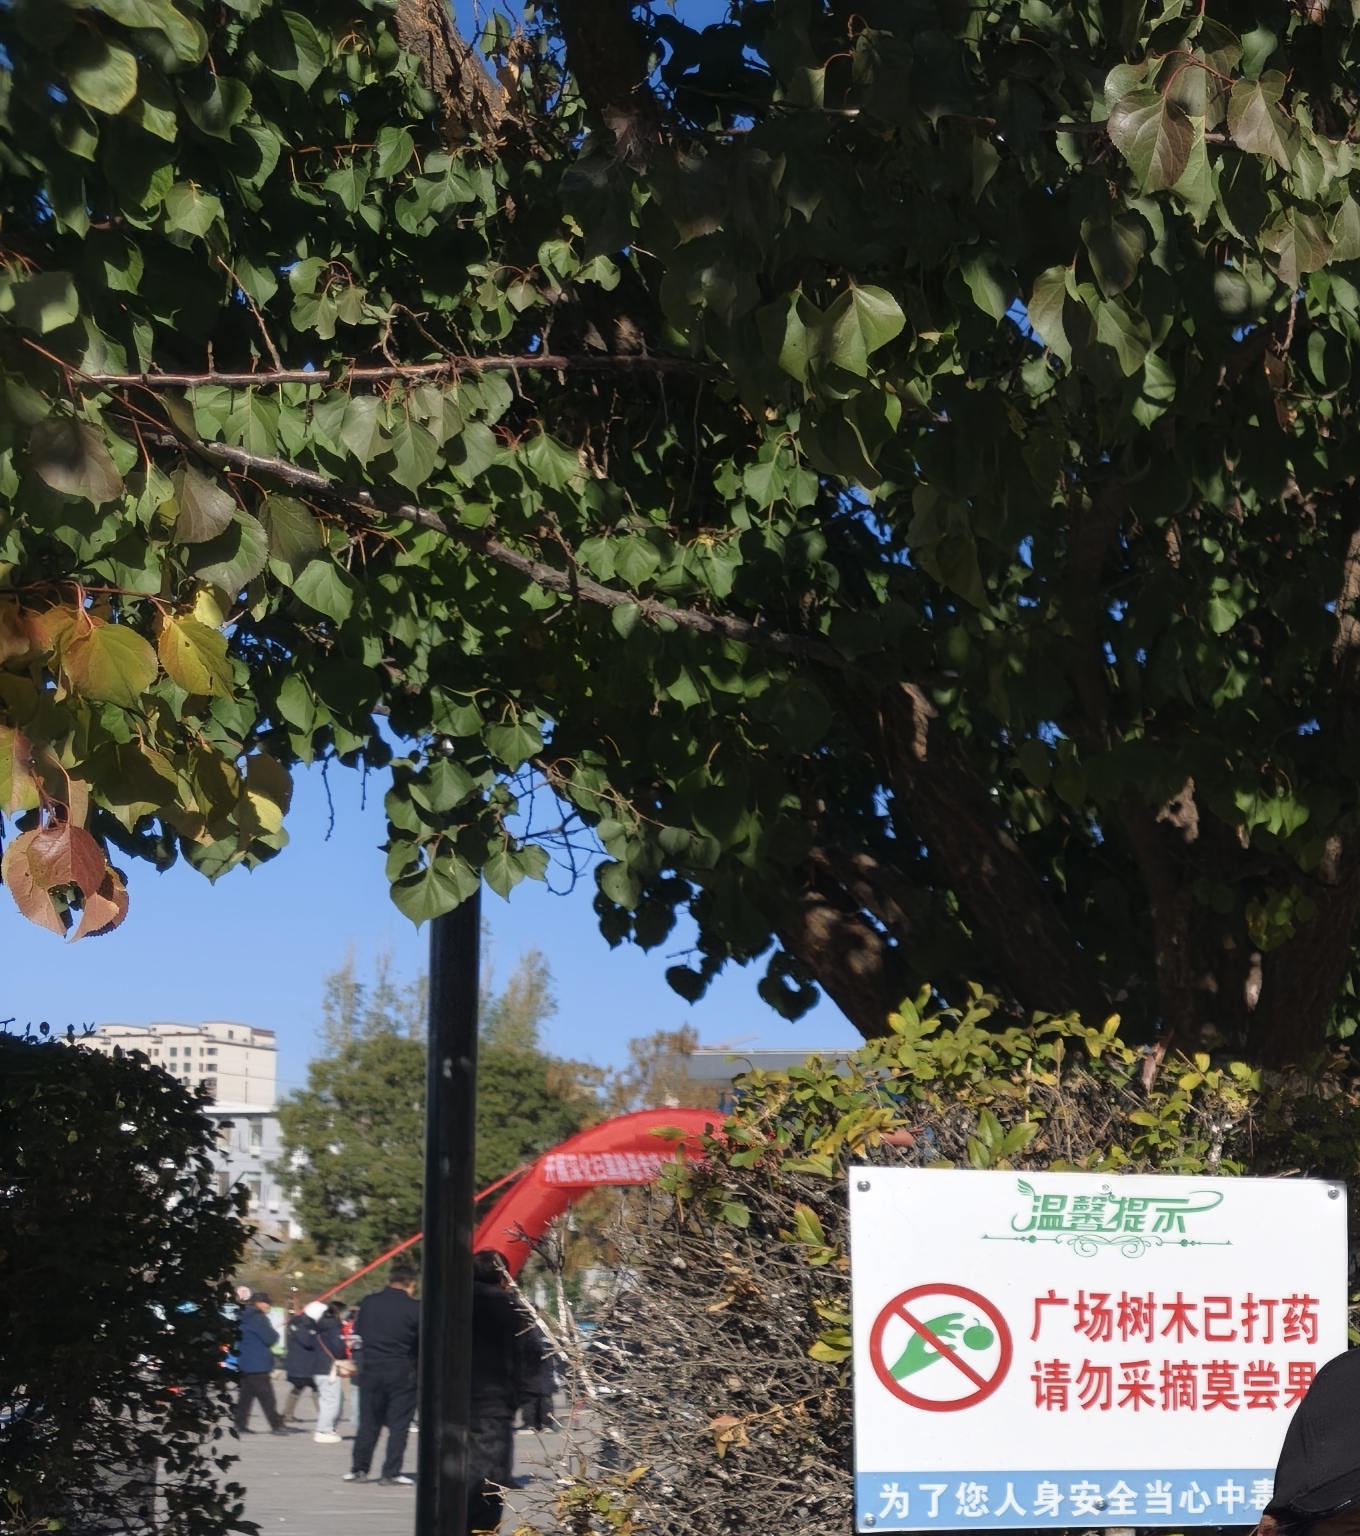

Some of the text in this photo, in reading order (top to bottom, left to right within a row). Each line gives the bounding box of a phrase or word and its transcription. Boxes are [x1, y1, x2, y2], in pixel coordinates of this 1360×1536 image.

[1010, 1178, 1225, 1234] 温馨提示
[1030, 1289, 1320, 1345] 广场树木已打药
[1030, 1358, 1317, 1412] 请勿采摘莫尝果
[878, 1477, 1275, 1519] 为了您人身安全当心中毒
